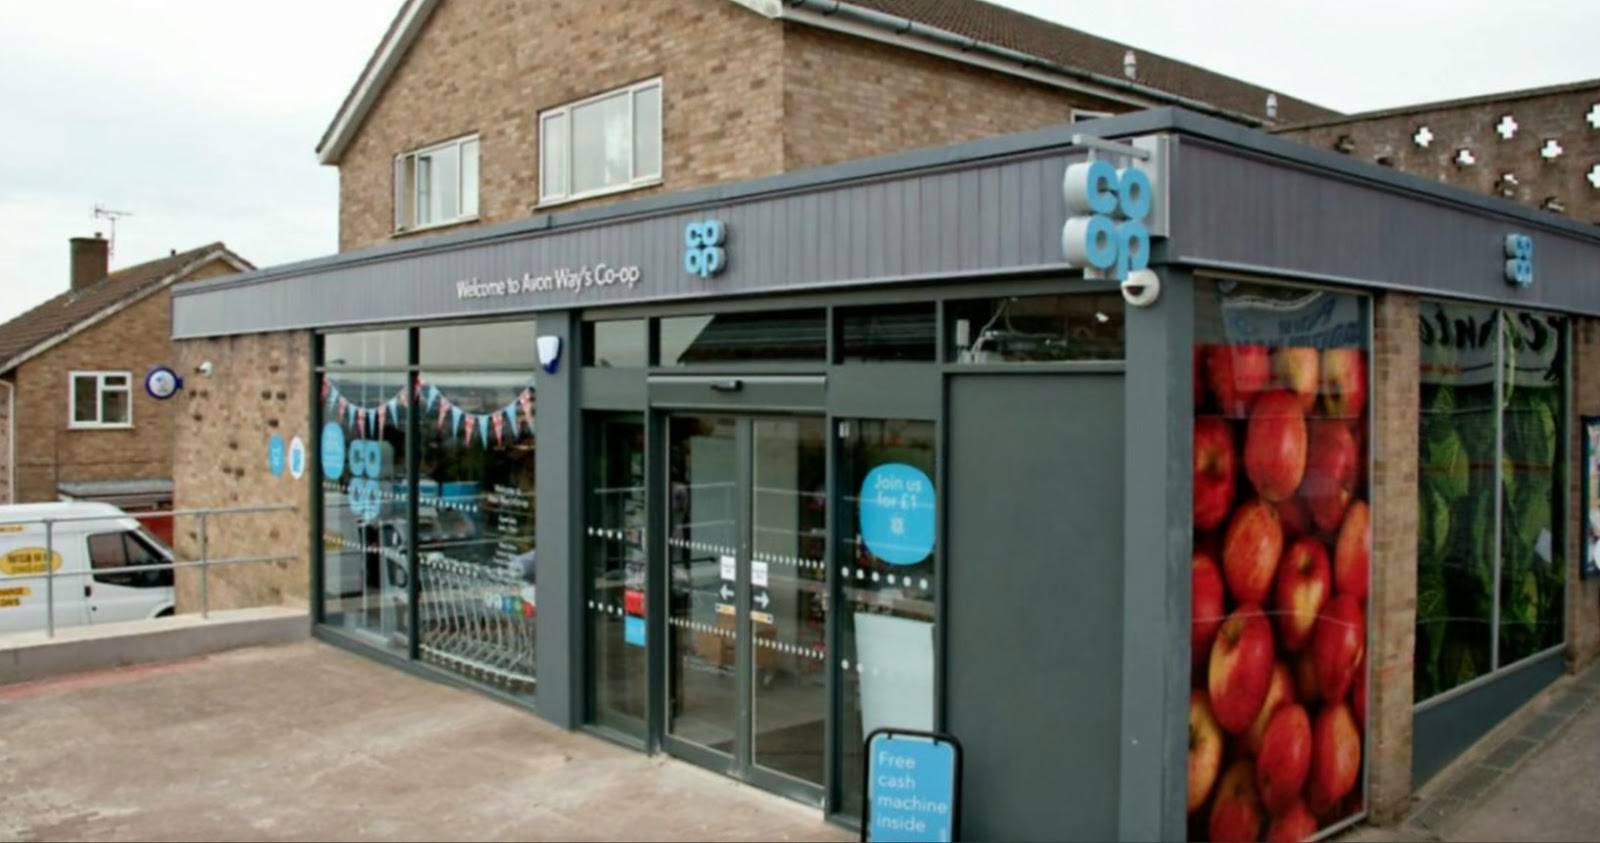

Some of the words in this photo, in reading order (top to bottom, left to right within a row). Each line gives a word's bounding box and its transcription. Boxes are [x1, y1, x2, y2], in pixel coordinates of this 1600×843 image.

[456, 277, 505, 299] Welcome
[507, 277, 520, 294] to
[521, 273, 553, 293] Avon
[554, 264, 593, 293] Way's
[595, 263, 640, 289] Co-op
[874, 474, 903, 490] Join
[906, 480, 922, 492] us
[876, 491, 897, 507] for
[879, 751, 916, 769] Free
[878, 772, 916, 789] cash
[878, 794, 947, 814] machine
[877, 812, 926, 833] inside
